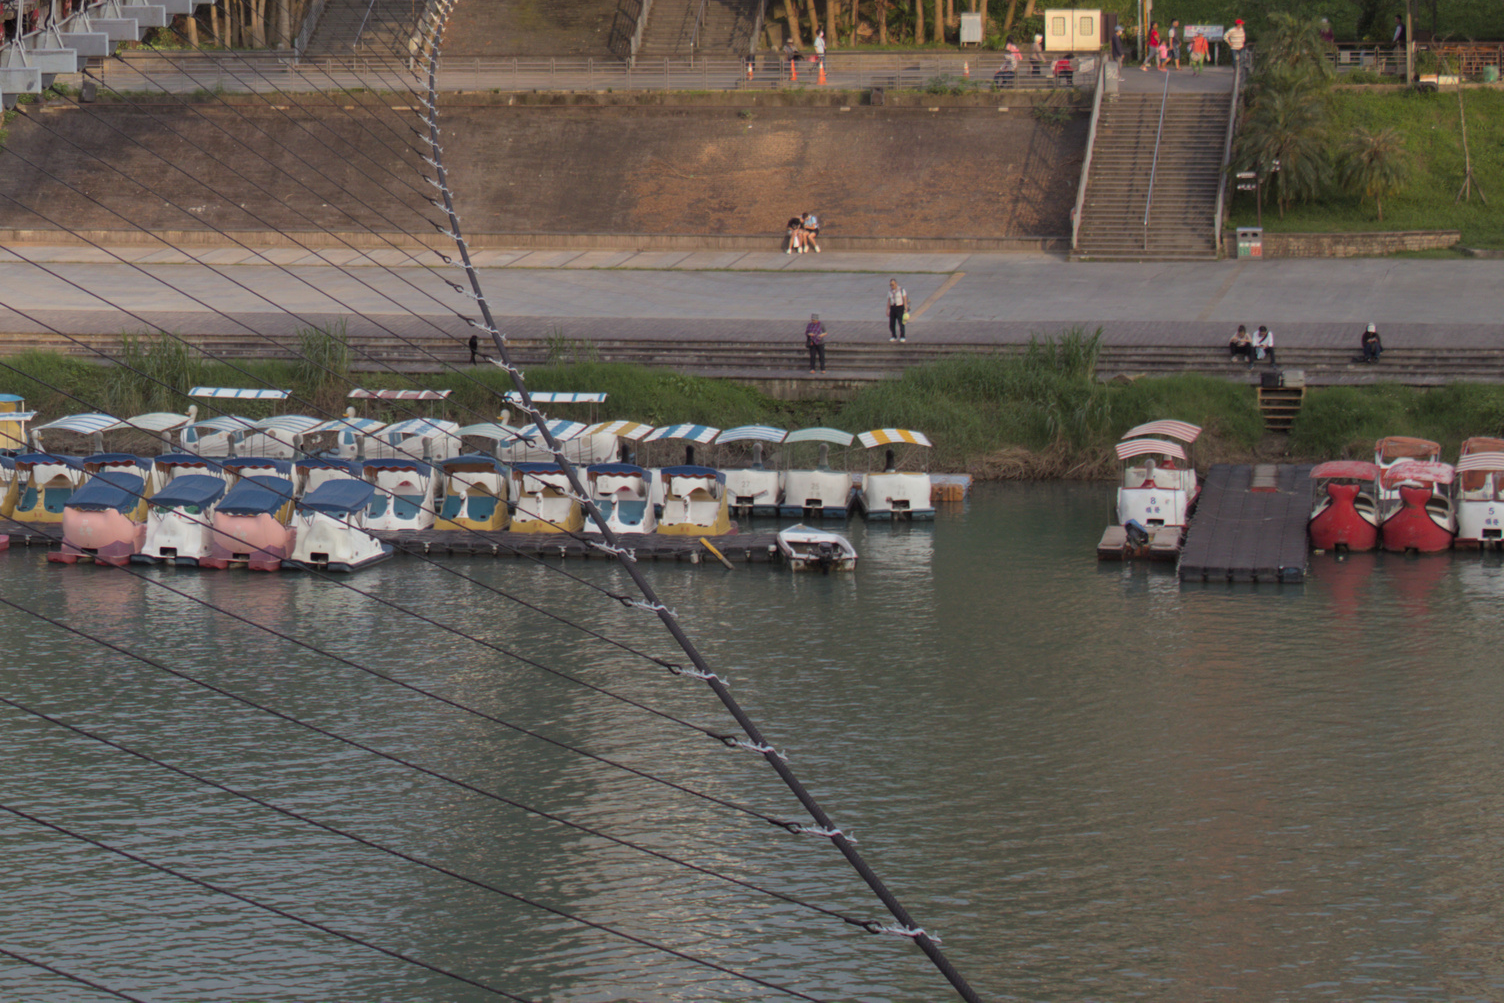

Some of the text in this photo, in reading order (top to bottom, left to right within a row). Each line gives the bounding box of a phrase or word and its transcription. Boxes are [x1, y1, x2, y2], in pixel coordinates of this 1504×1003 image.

[741, 480, 751, 488] 27
[1150, 497, 1157, 505] 8
[1488, 507, 1495, 516] 5
